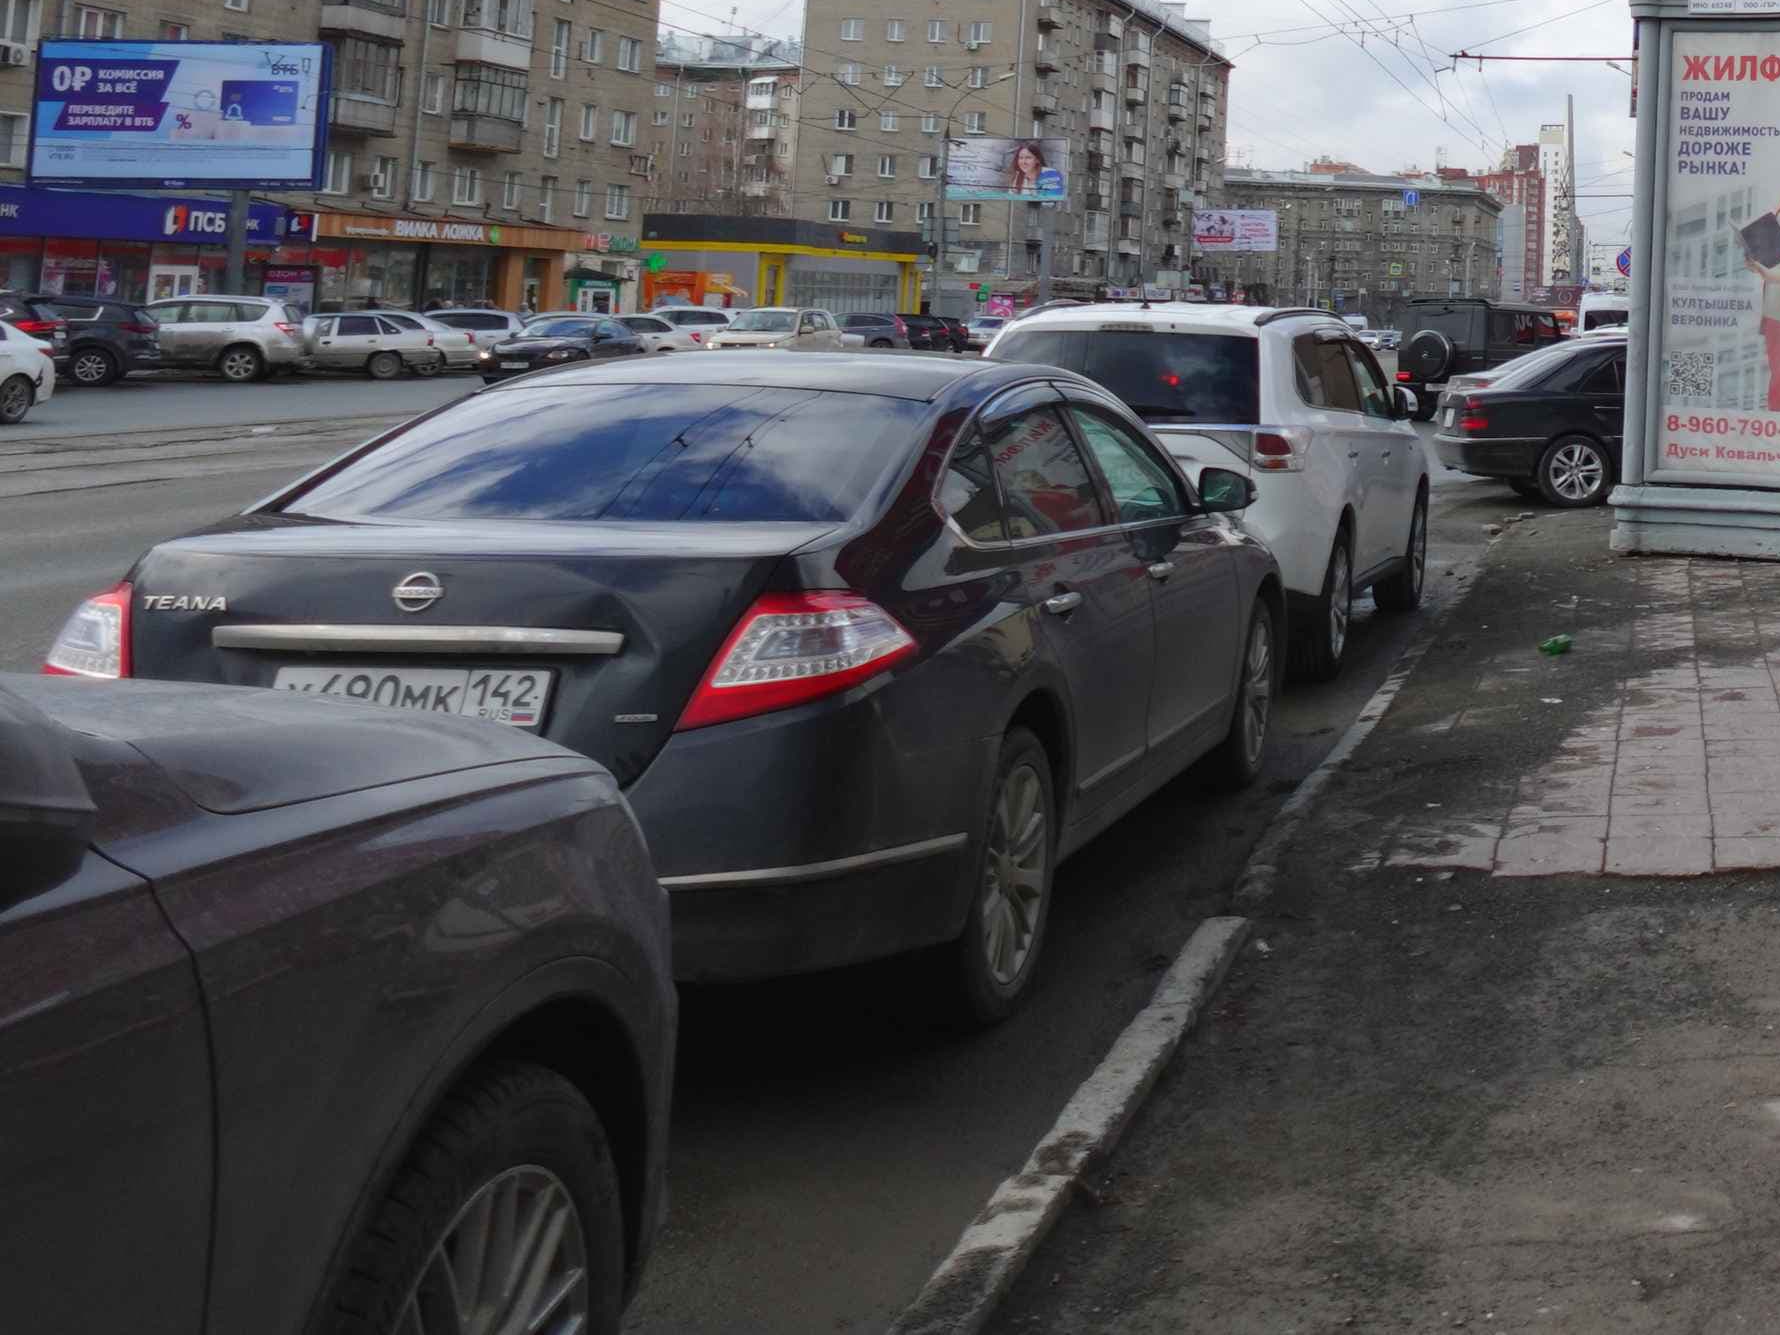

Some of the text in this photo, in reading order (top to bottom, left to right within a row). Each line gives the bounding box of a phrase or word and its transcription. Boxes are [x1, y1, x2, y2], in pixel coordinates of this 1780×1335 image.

[98, 69, 165, 80] КОМИССИЯ
[96, 80, 138, 93] ЗА ВСЁ
[1680, 91, 1730, 102] ПРОДАМ
[68, 105, 135, 116] ПЕРЕВЕДИТЕ
[1680, 106, 1730, 120] ВАШУ
[67, 116, 123, 126] ЗАРПЛАТУ
[1679, 125, 1780, 138] НЕДВИЖИМОСТЬ
[1678, 141, 1751, 157] ДОРОЖЕ
[1678, 160, 1747, 175] РЫНКА!
[189, 209, 227, 233] ПСБ
[395, 219, 438, 240] ВИЛКА
[441, 222, 484, 242] ЛОЖКА
[1671, 314, 1739, 327] ВЕРОНИКА
[143, 594, 227, 613] TEANA
[472, 674, 536, 707] 142
